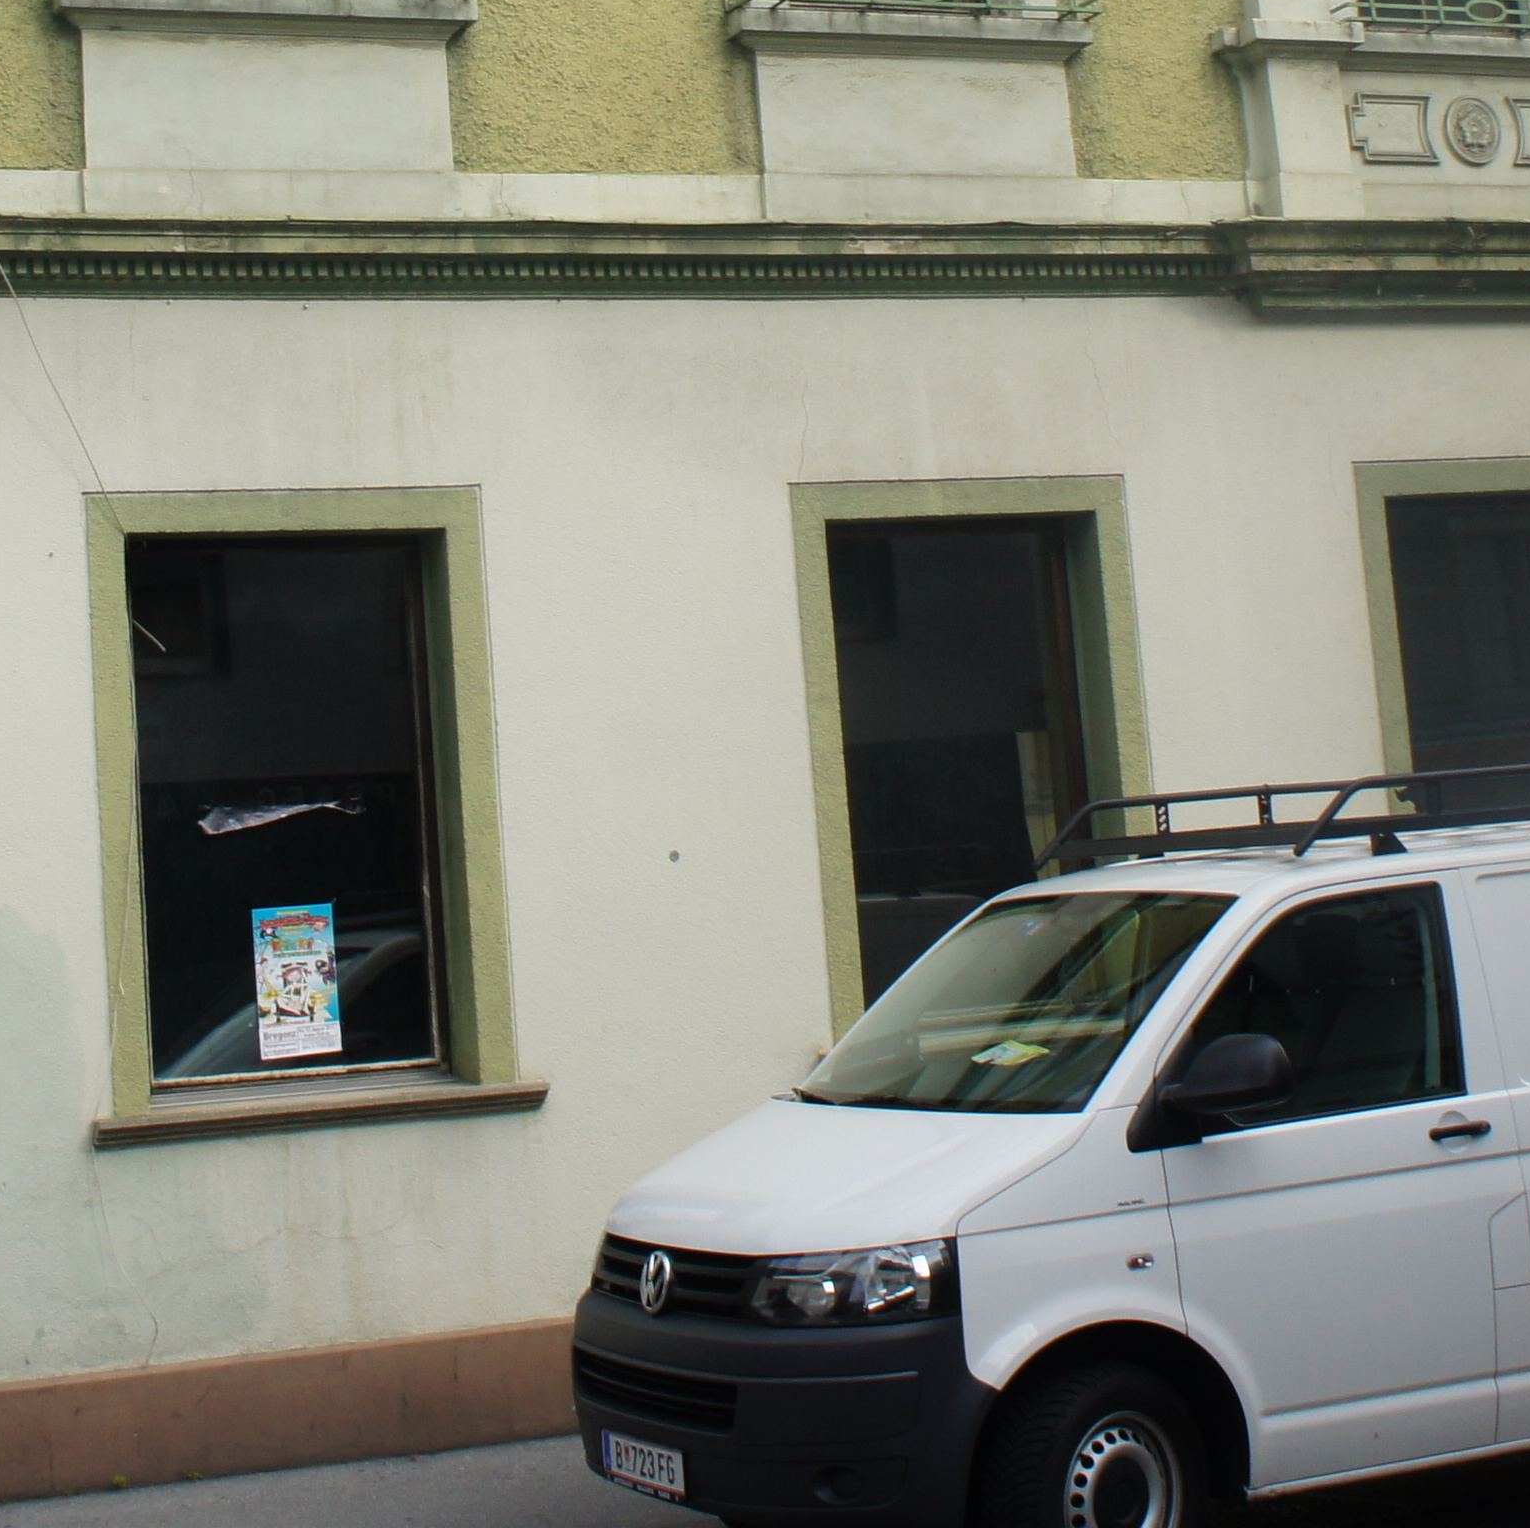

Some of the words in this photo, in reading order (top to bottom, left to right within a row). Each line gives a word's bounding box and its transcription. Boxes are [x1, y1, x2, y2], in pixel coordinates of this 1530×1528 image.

[615, 1440, 623, 1469] B
[631, 1445, 656, 1479] 723
[658, 1452, 675, 1484] FG
